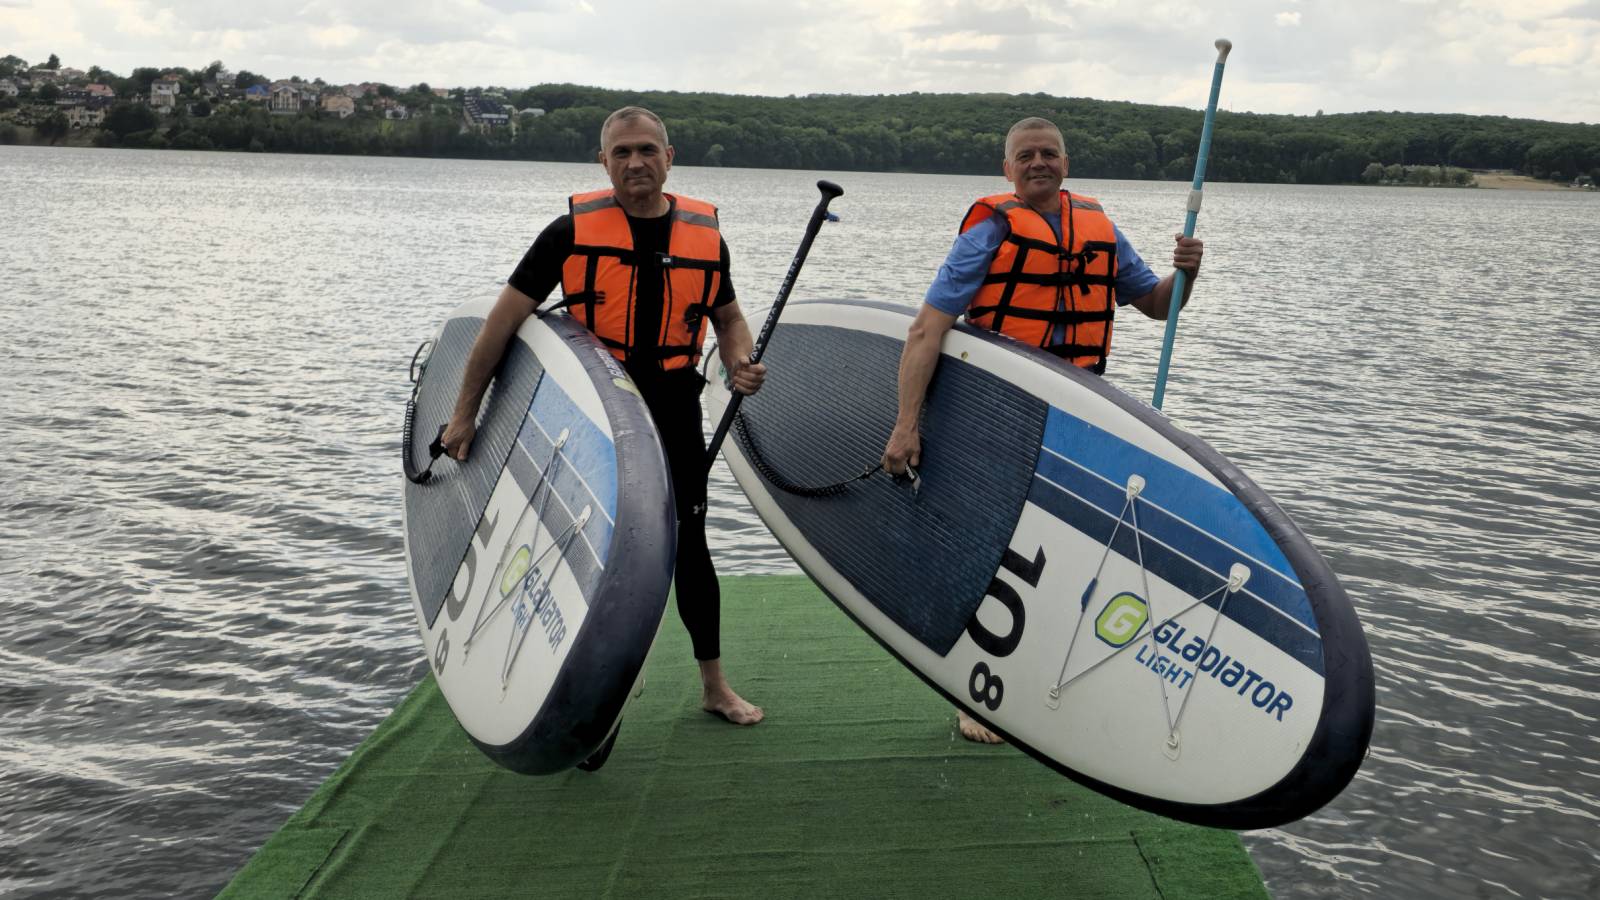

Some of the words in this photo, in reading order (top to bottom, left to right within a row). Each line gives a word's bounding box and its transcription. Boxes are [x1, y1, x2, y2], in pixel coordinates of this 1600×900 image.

[1103, 604, 1143, 636] G
[968, 661, 1005, 712] 8
[1135, 644, 1194, 689] LIGHT
